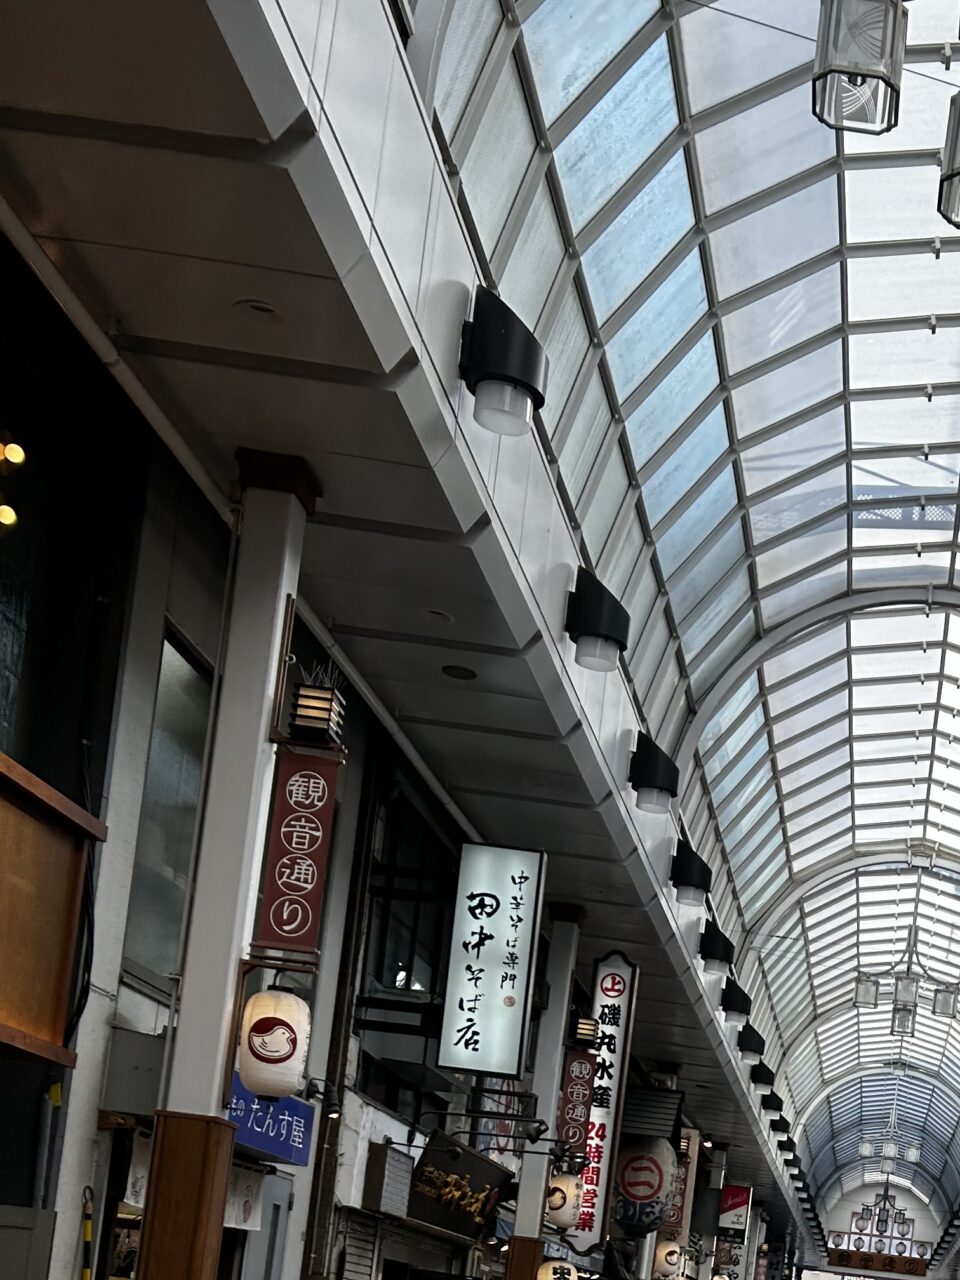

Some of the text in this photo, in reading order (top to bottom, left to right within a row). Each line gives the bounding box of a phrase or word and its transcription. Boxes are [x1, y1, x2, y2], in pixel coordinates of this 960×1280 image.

[269, 770, 328, 937] 観音通り
[454, 892, 500, 1052] 田中そば店
[501, 870, 529, 990] 中華そば専門
[562, 1059, 592, 1146] 観音通り
[592, 1003, 621, 1109] 磯丸水産
[247, 1098, 305, 1148] たんす屋
[575, 1122, 606, 1232] 24時間営業
